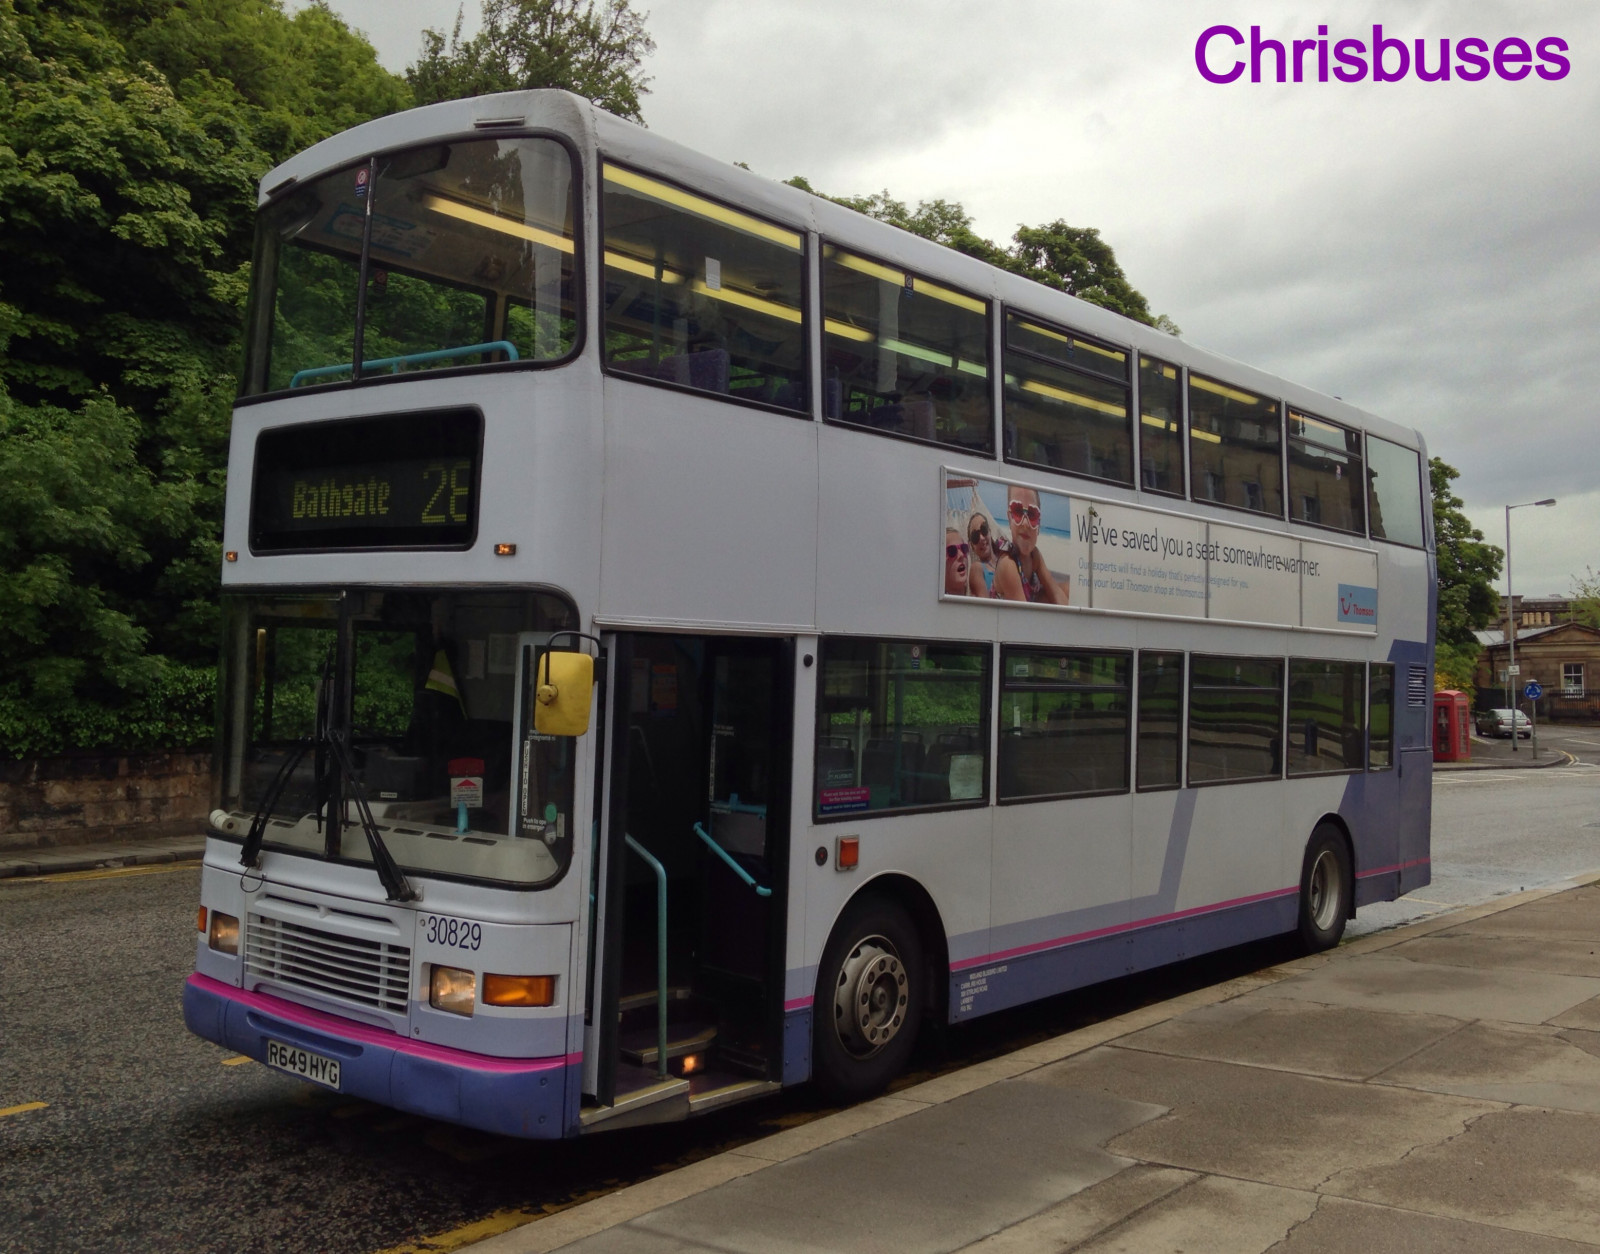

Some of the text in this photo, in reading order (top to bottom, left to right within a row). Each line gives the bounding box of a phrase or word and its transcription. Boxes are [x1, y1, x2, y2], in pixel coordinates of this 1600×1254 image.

[293, 476, 390, 518] Bathgate
[1077, 514, 1320, 577] We've saved you a seat somewhere warmer.
[1094, 561, 1117, 573] experts
[1119, 563, 1128, 574] will
[1130, 564, 1142, 576] find
[1148, 567, 1167, 581] holiday
[1094, 579, 1109, 590] your
[1111, 578, 1125, 590] local
[1127, 579, 1153, 593] Thomson
[1154, 584, 1168, 596] shop
[1168, 586, 1175, 595] at
[1353, 603, 1375, 616] Thomson
[427, 916, 482, 951] 30829
